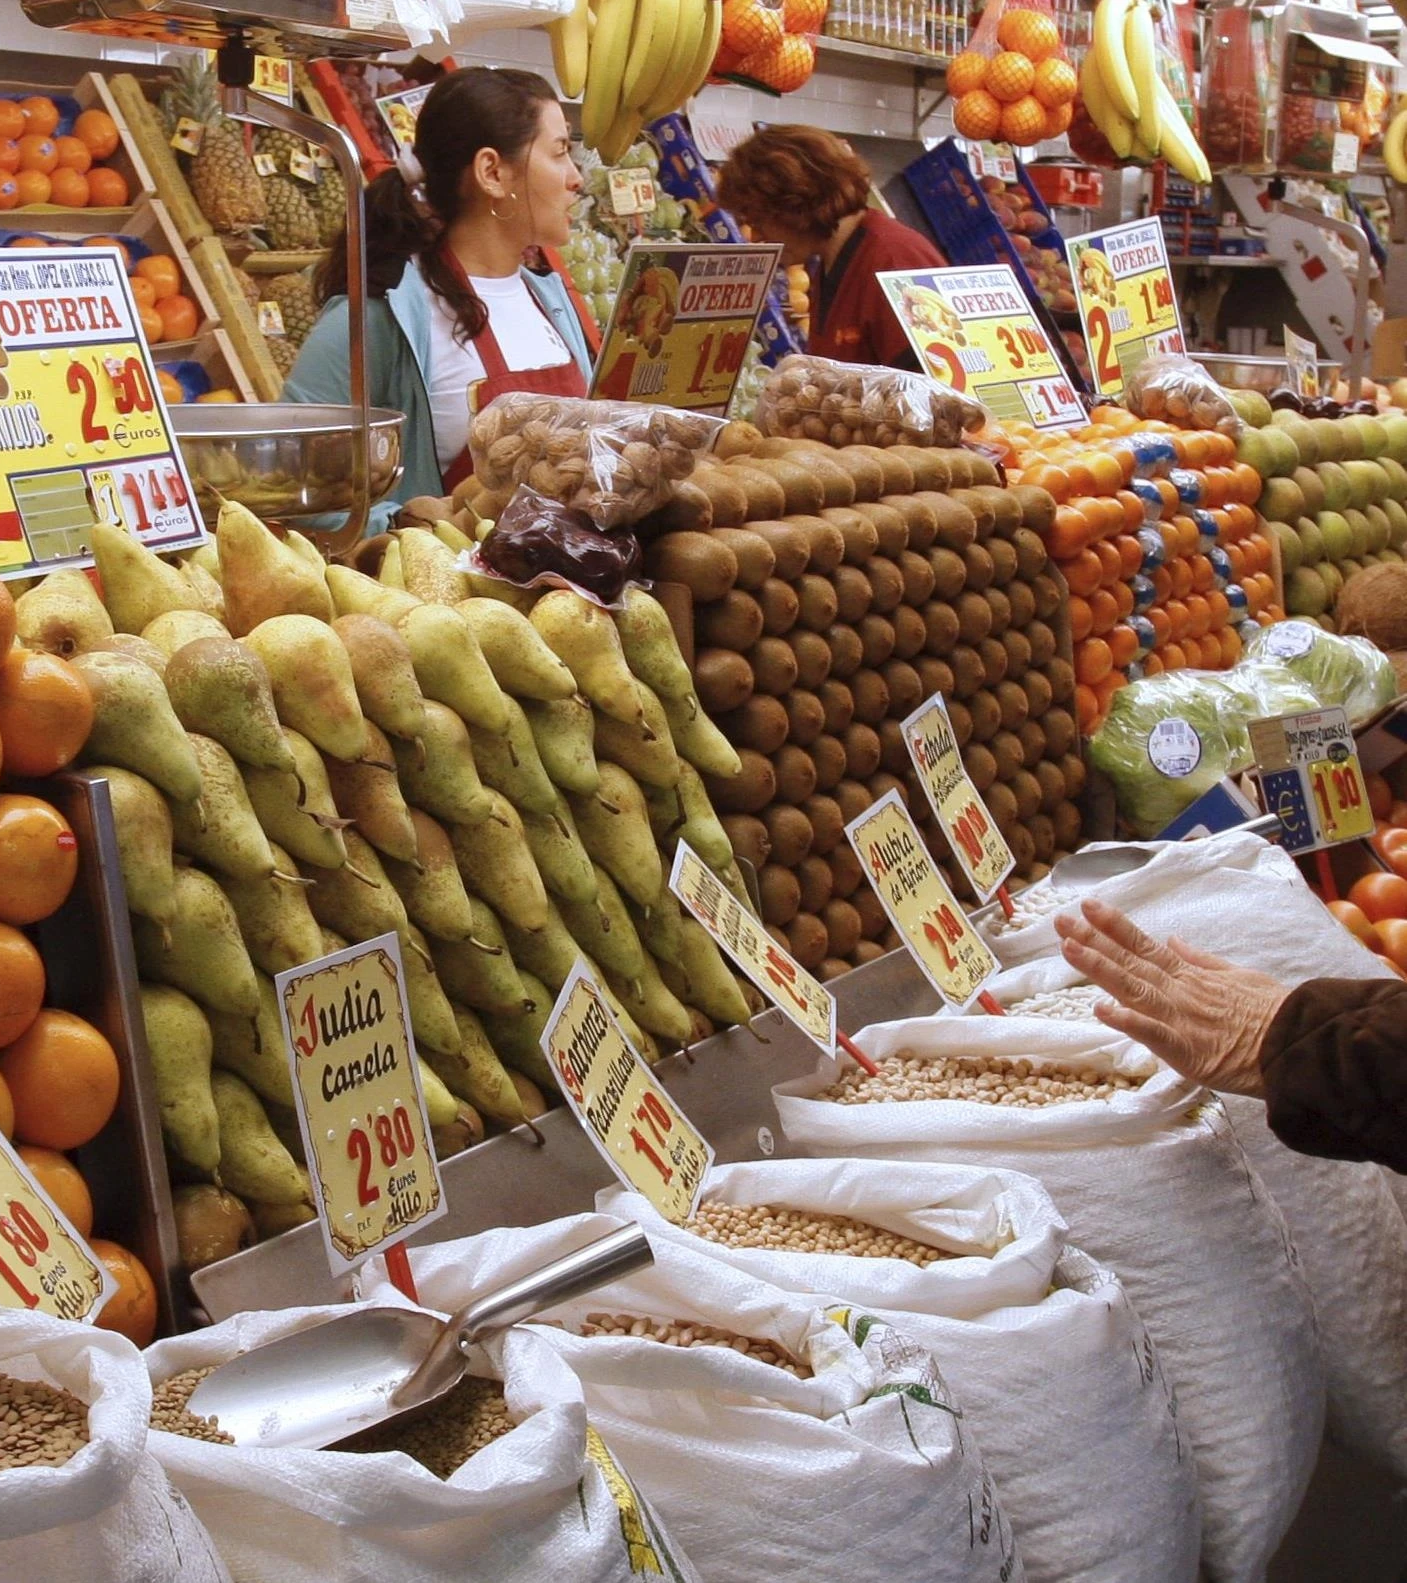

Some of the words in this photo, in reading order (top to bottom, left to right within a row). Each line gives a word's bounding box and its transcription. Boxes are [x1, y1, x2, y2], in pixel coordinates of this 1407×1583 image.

[1111, 244, 1161, 274] OFERTA
[679, 282, 757, 314] OFERTA
[951, 291, 1022, 315] OFERTA
[1087, 306, 1123, 386] 2
[913, 723, 954, 776] Fabada
[868, 827, 914, 885] Alubia
[557, 996, 609, 1104] Garbanzo
[346, 1106, 415, 1208] 2'80
